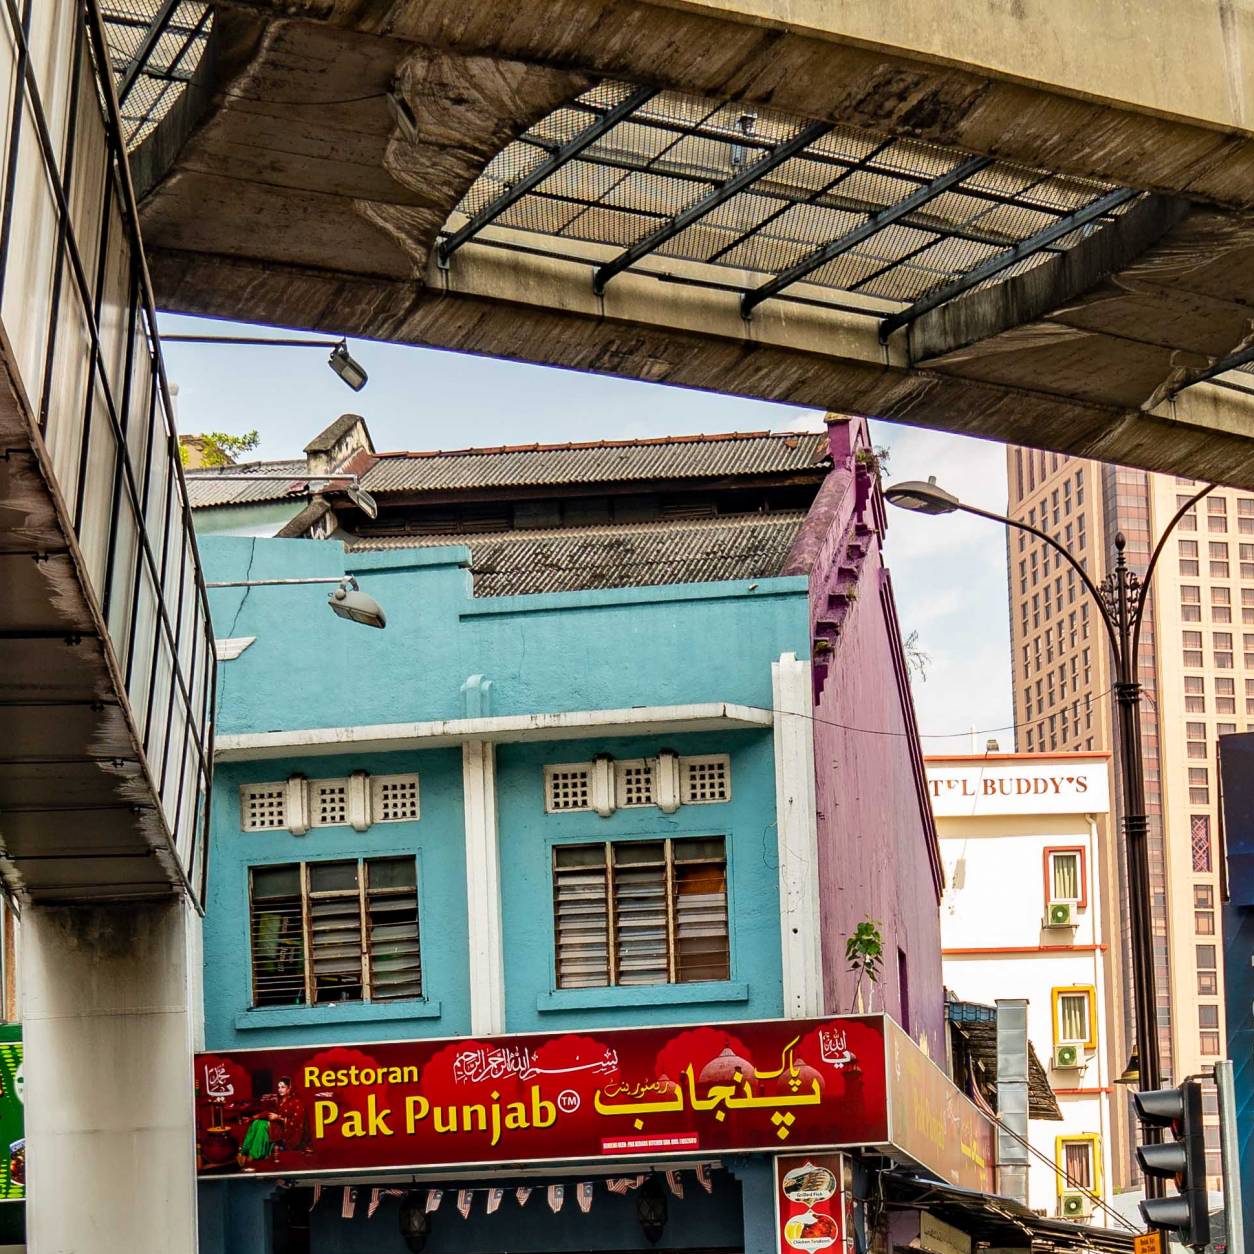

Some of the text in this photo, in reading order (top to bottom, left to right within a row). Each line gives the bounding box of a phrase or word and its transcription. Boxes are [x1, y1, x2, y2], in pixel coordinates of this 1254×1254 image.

[304, 1063, 419, 1088] Restoran
[314, 1094, 393, 1139] Pak
[405, 1085, 557, 1147] Punjab
